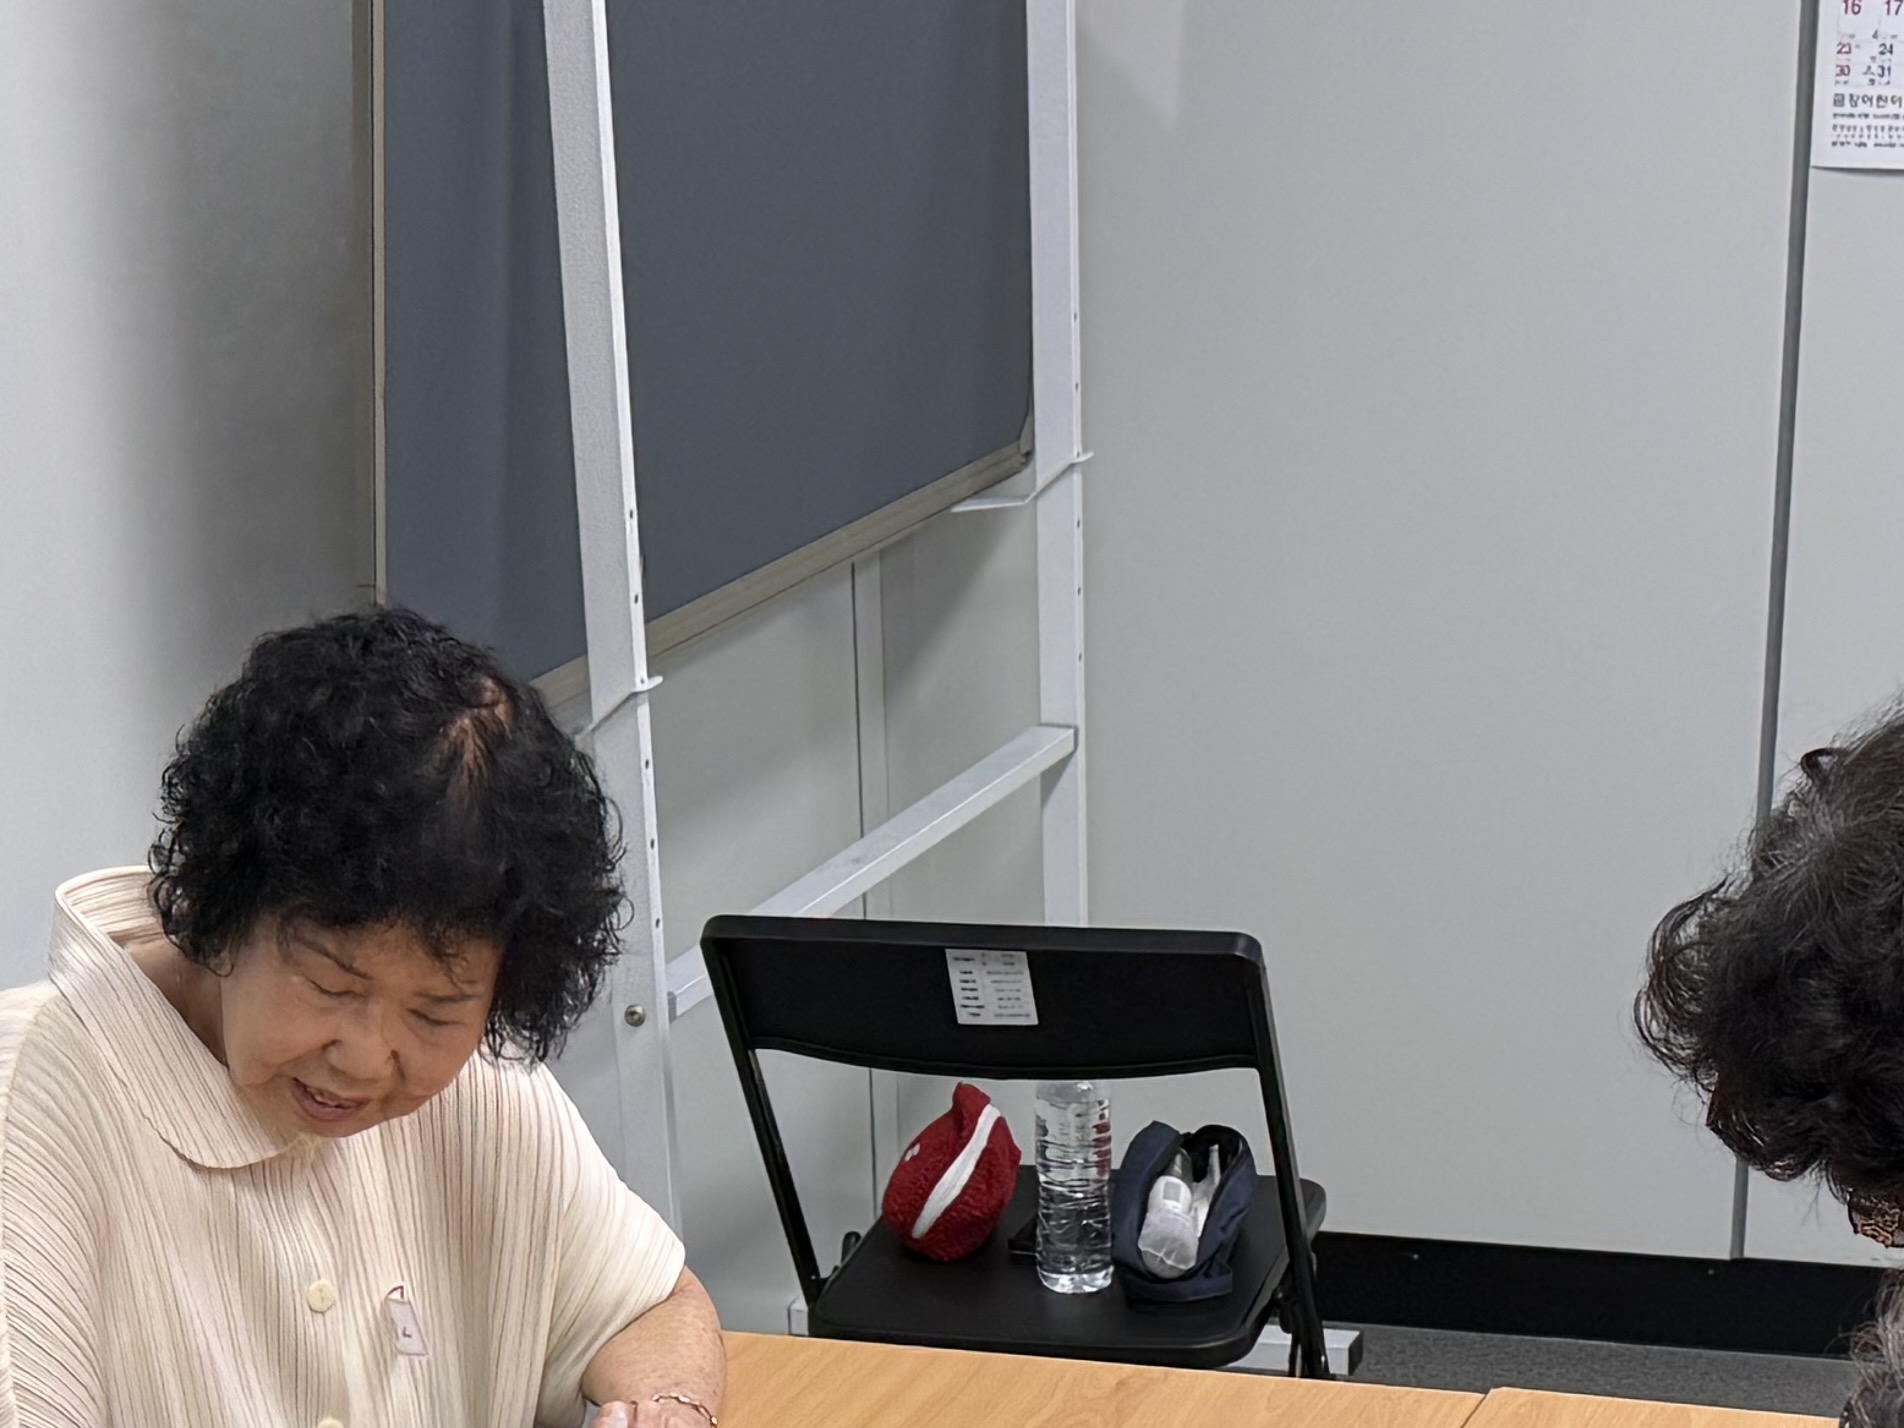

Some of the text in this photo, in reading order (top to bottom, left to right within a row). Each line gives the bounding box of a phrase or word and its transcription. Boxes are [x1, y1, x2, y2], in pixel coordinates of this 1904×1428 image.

[1842, 0, 1862, 15] 16
[1884, 0, 1904, 16] 17
[1878, 43, 1894, 56] 24
